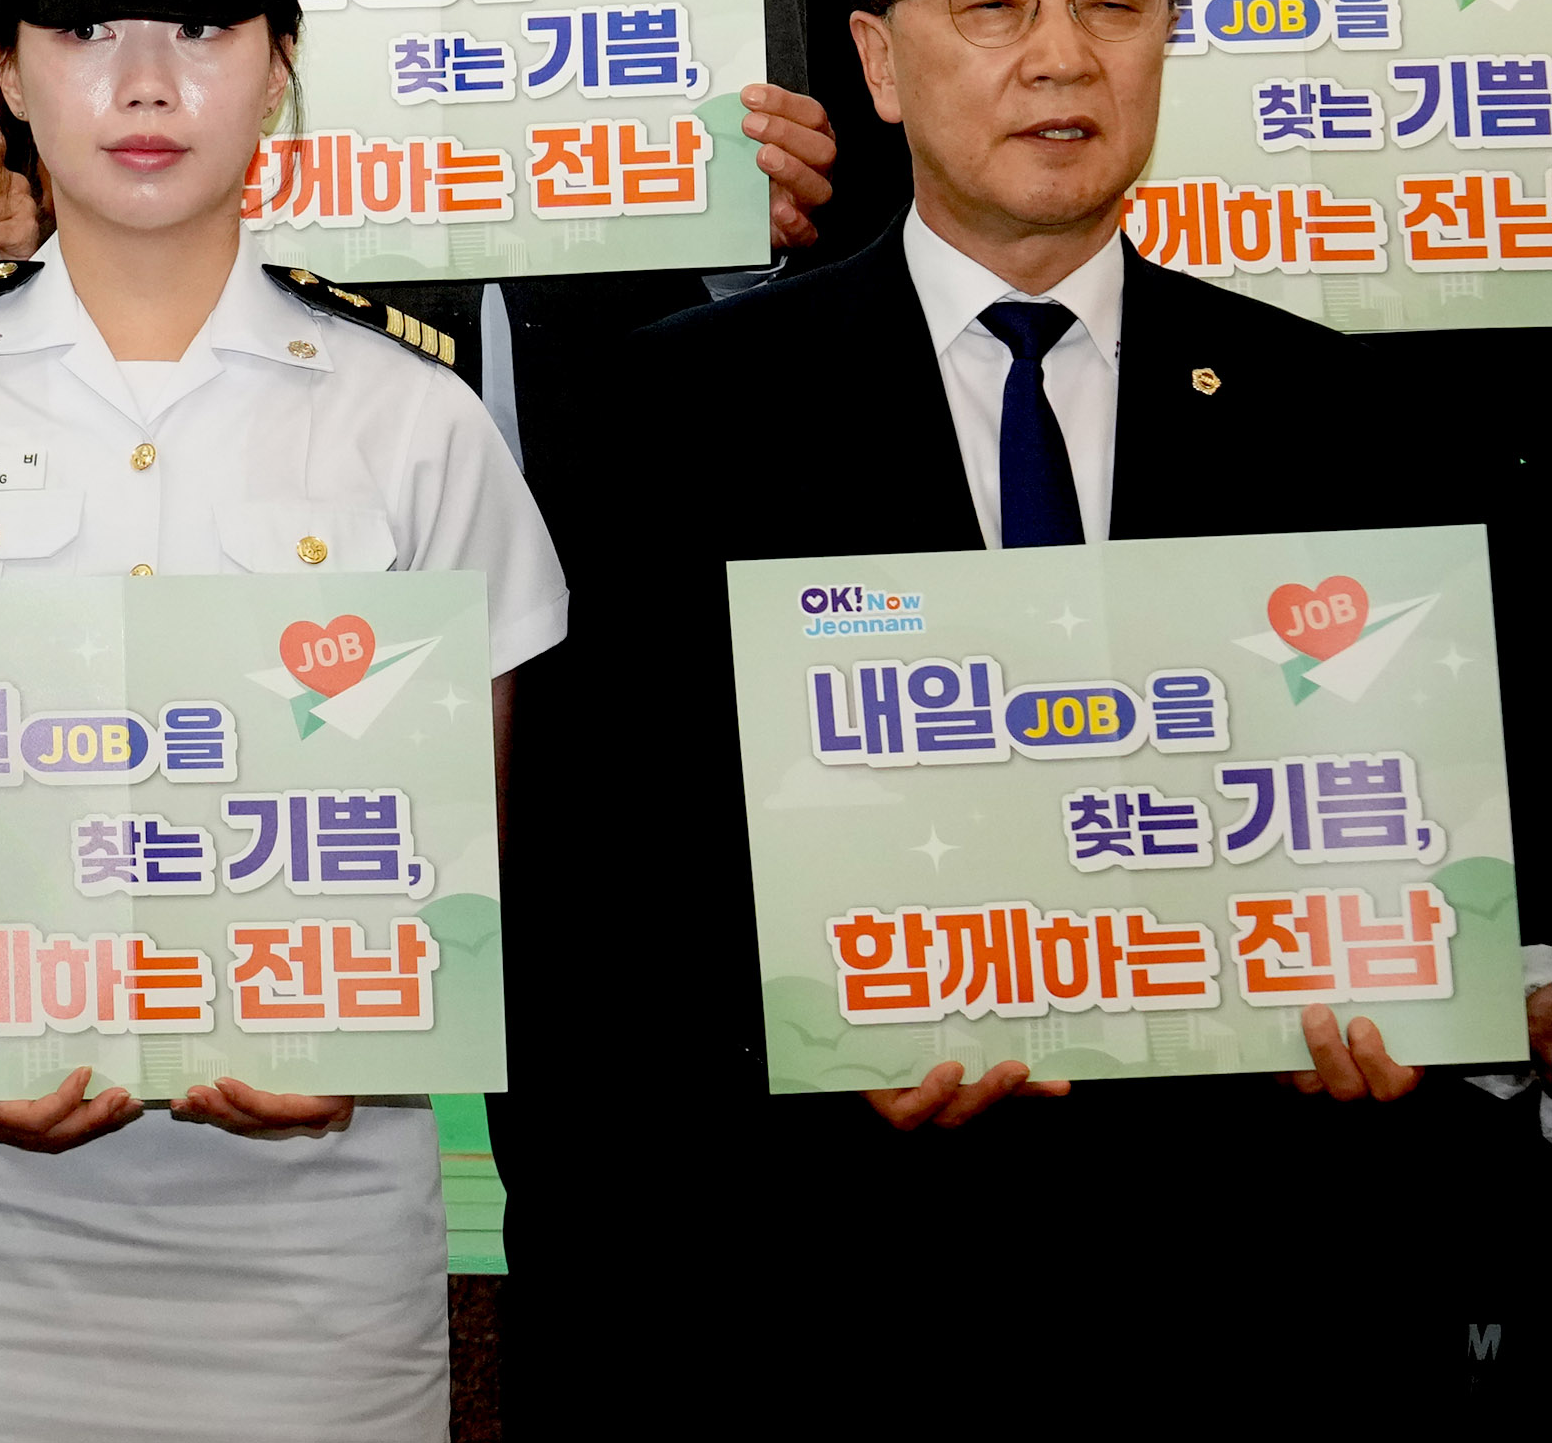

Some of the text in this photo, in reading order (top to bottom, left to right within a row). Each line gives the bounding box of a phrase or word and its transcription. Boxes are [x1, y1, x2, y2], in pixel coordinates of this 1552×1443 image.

[395, 9, 697, 94] 찾는 기쁨,
[1259, 84, 1373, 141] 찾는
[531, 122, 701, 208] 전남
[801, 588, 921, 614] OK! Now
[805, 614, 923, 636] Jeonnam
[1286, 593, 1357, 636] JOB
[296, 632, 365, 674] JOB
[38, 725, 131, 765] JOB
[165, 707, 226, 770] 을
[813, 663, 1215, 756] 내일 JOB 을
[78, 795, 423, 887] 찾는 기쁨,
[1069, 758, 1433, 860] 찾는 기쁨,
[235, 924, 426, 1020] 전남
[834, 890, 1440, 1012] 함께하는 전남
